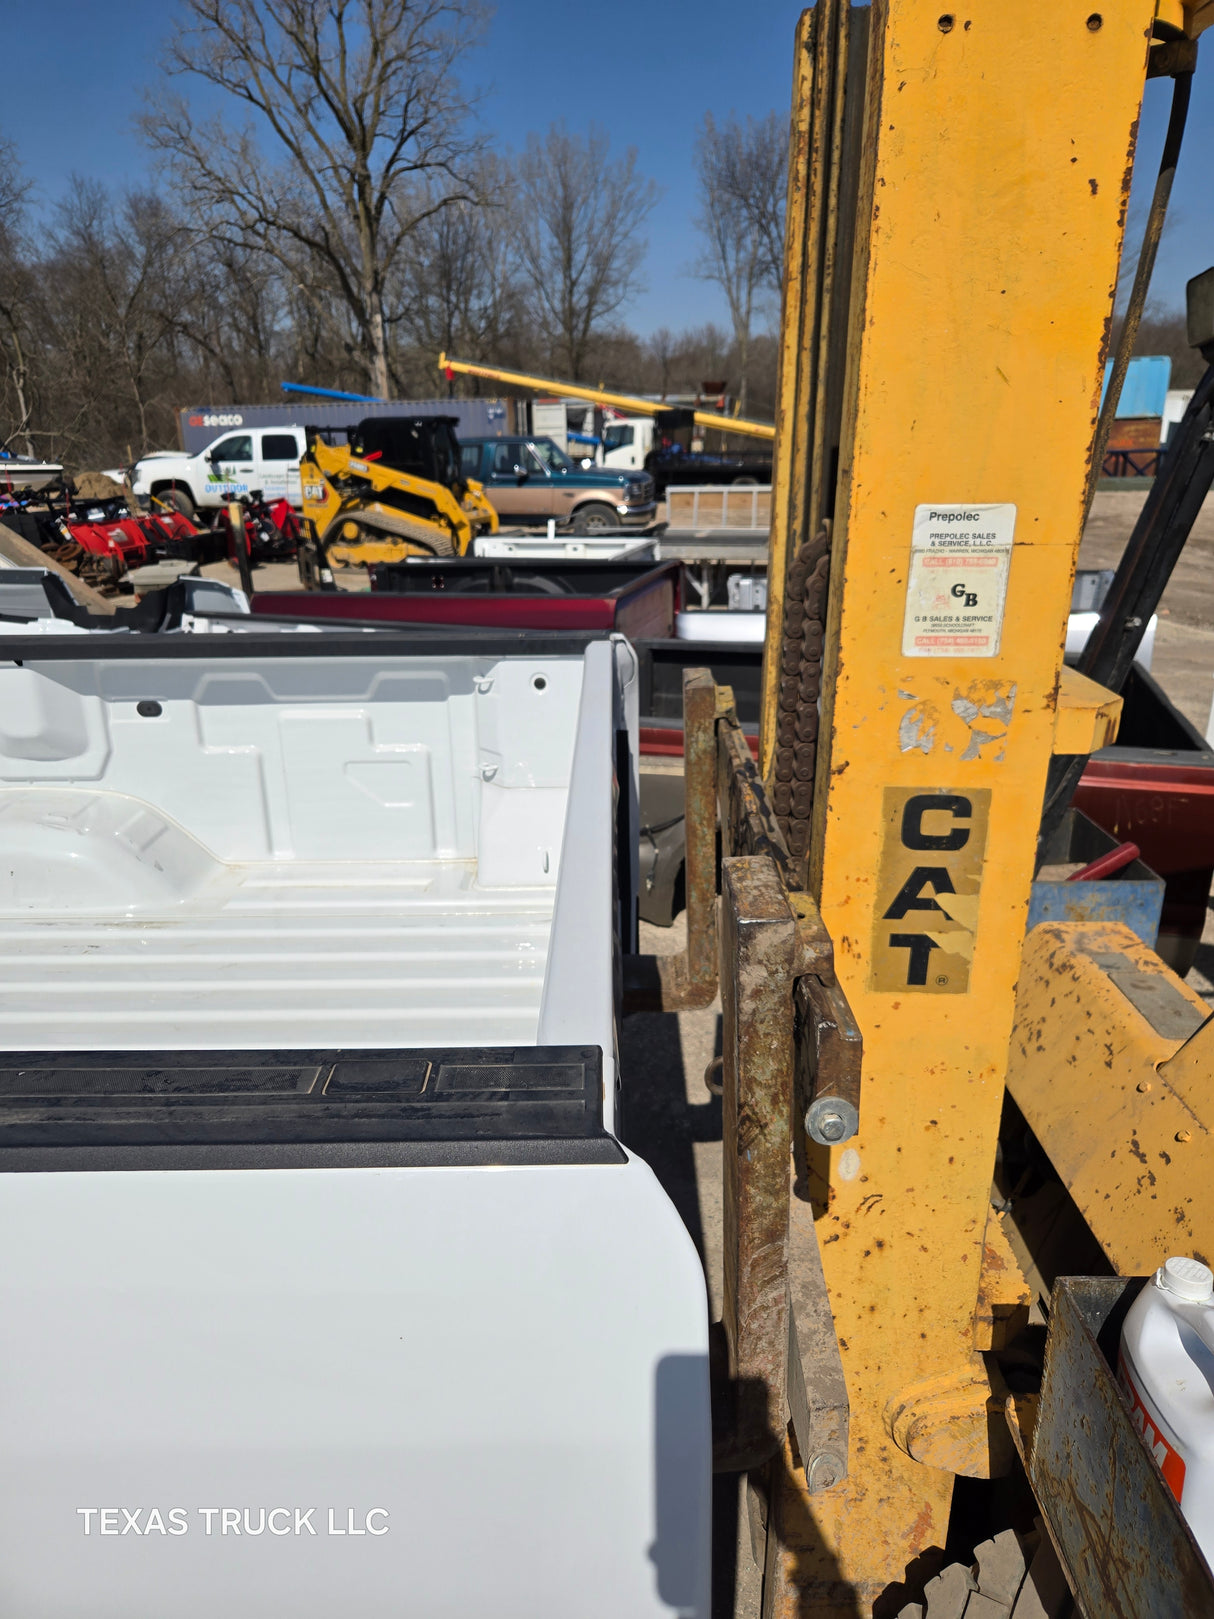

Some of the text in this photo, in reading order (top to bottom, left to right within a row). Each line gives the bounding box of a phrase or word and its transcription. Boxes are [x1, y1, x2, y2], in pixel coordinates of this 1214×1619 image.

[304, 486, 324, 500] CAT
[928, 511, 980, 523] Prepolec
[881, 794, 973, 986] CAT
